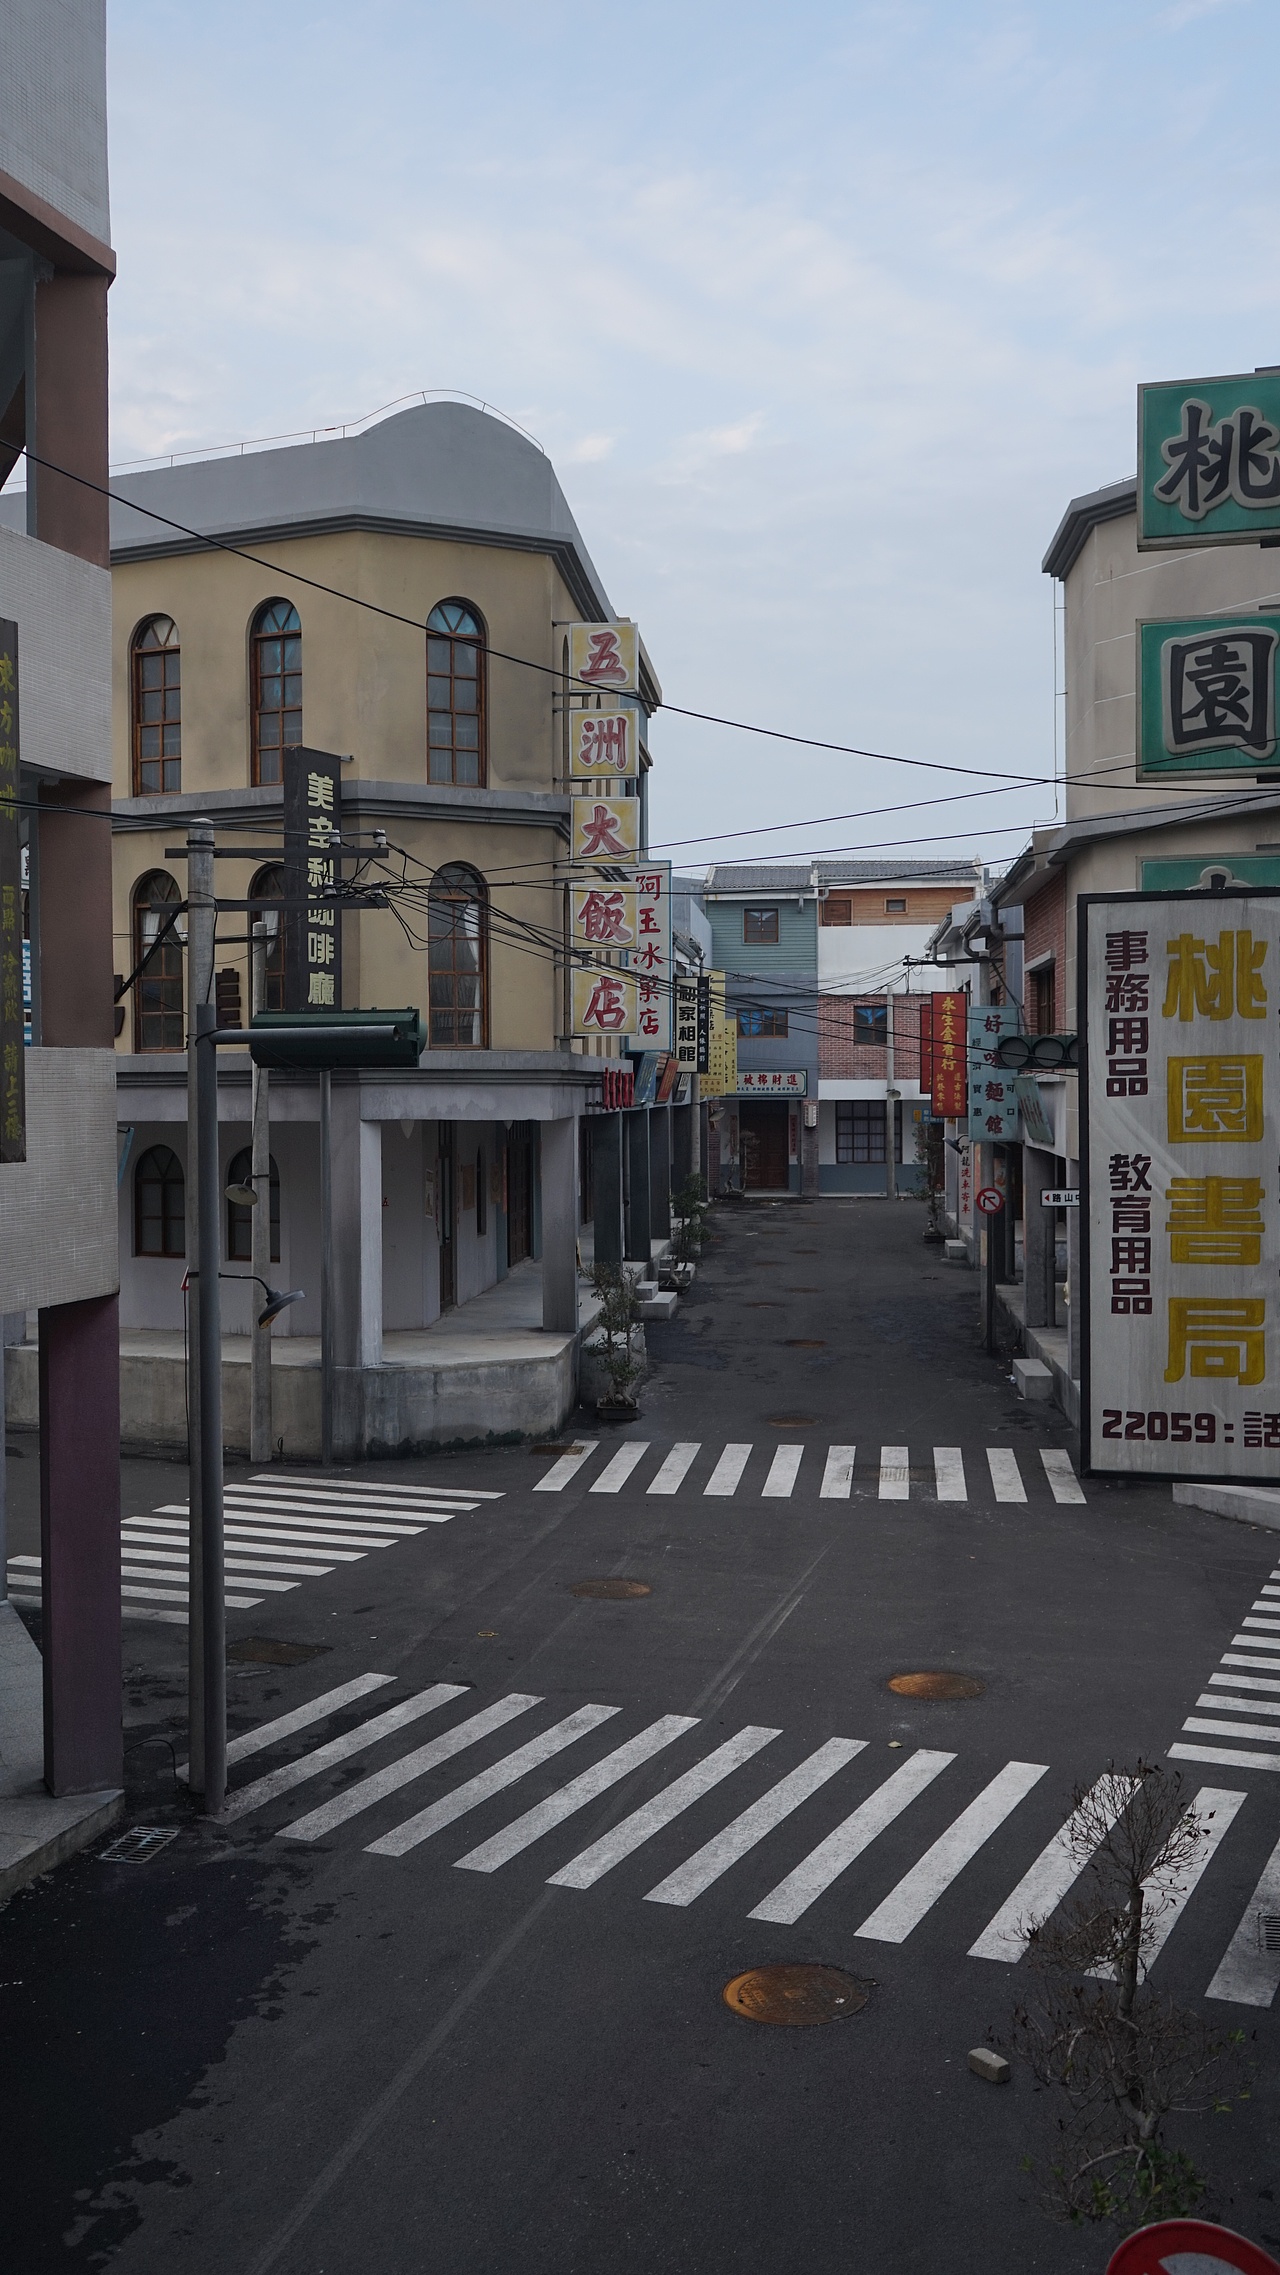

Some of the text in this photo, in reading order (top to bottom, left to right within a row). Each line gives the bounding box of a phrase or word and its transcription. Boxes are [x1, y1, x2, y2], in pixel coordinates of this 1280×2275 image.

[578, 629, 632, 1034] 五洲大飯店
[1156, 400, 1280, 889] 桃園
[1105, 930, 1153, 1316] 事務用品 教育用品
[1161, 929, 1267, 1386] 桃園書局
